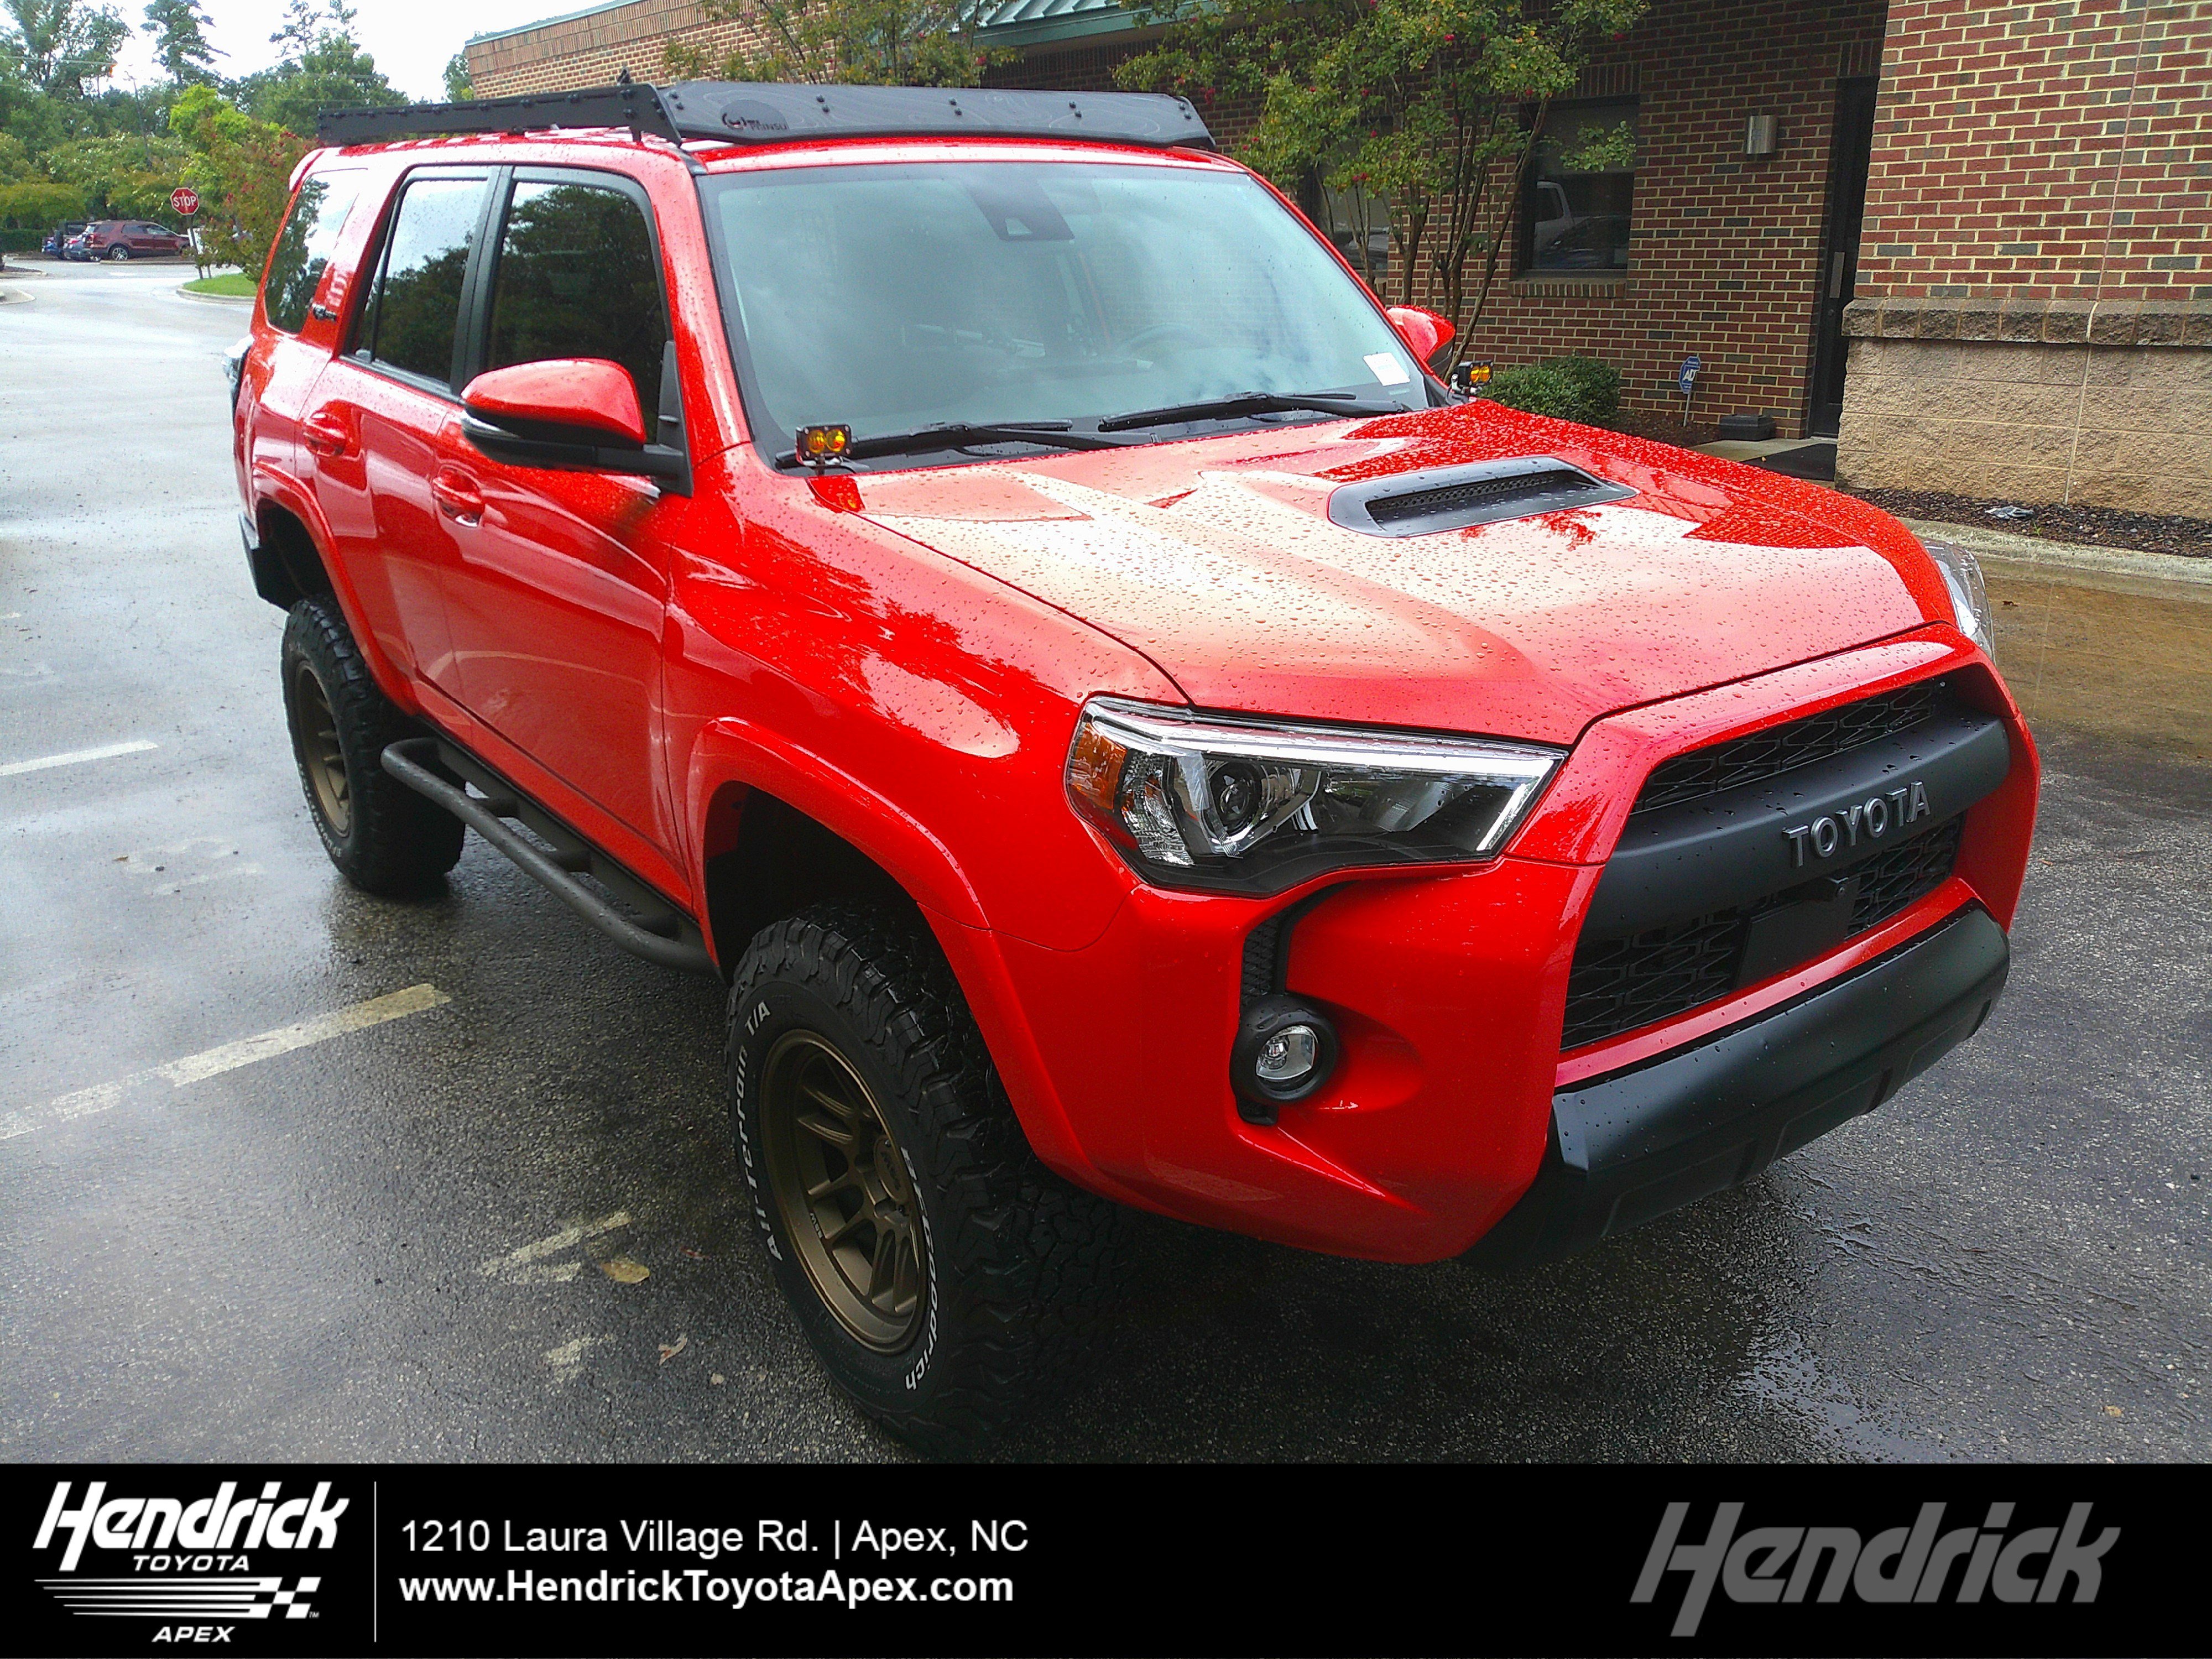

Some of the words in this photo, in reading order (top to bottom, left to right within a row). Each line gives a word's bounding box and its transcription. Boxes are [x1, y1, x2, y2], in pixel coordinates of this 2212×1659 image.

[173, 196, 196, 207] STOP
[1782, 780, 1931, 867] TOYOTA
[745, 1000, 771, 1036] T/A
